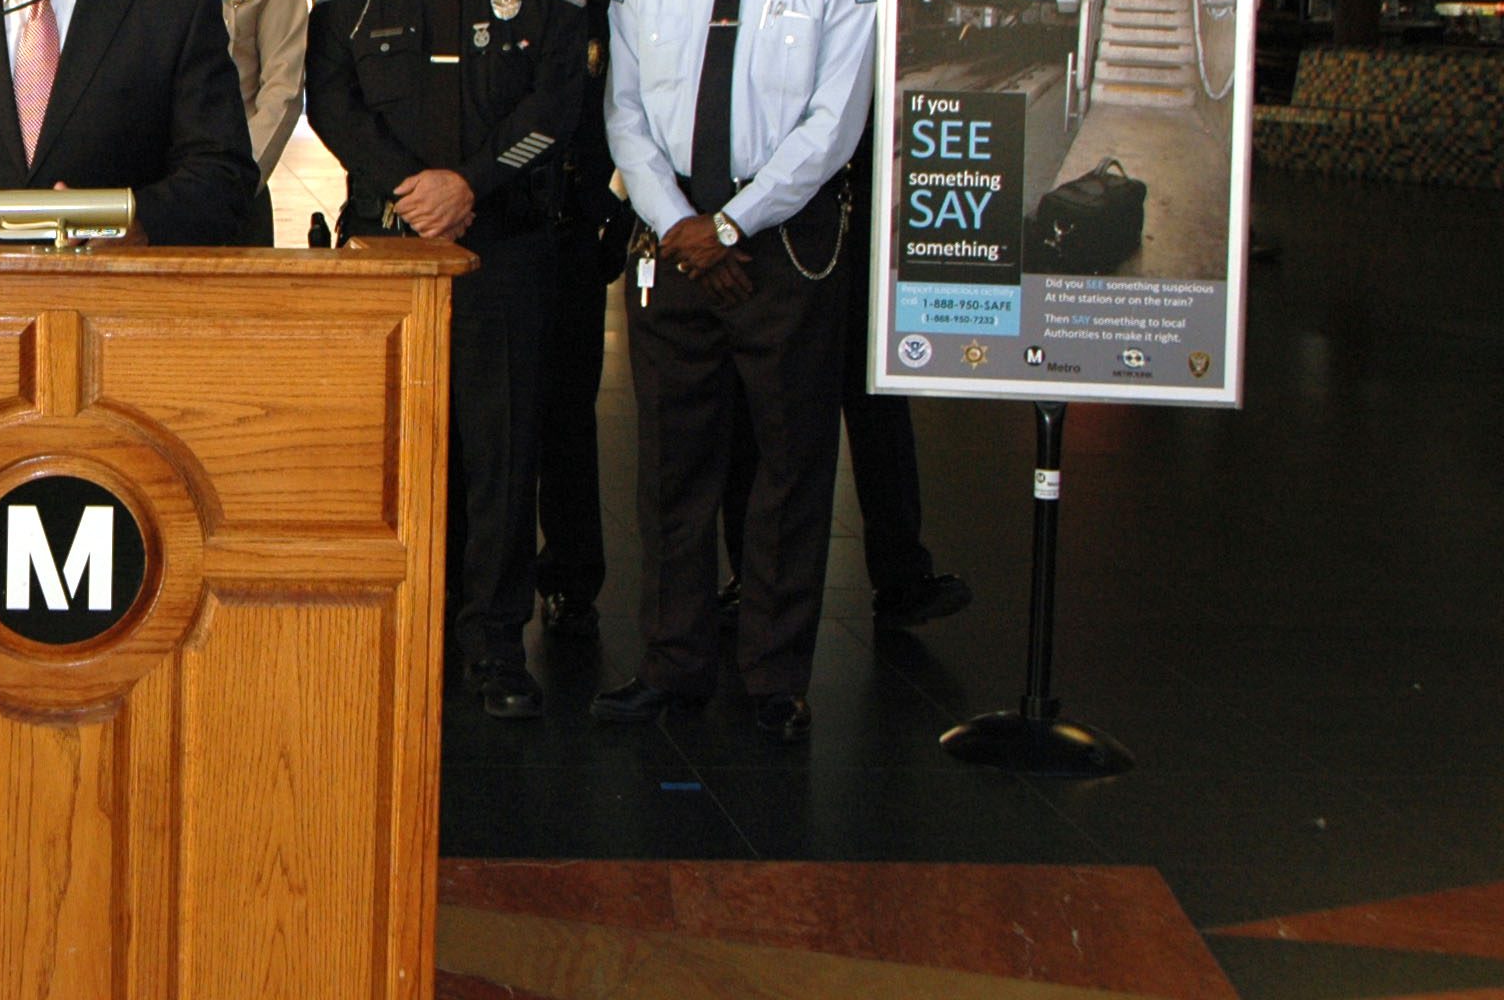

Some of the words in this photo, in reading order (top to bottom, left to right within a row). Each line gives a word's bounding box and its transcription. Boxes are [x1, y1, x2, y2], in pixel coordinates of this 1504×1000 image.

[912, 95, 924, 111] If
[928, 99, 960, 115] you
[911, 119, 992, 159] SEE
[909, 171, 1001, 191] something
[909, 189, 992, 229] SAY
[907, 240, 998, 261] something
[1045, 279, 1063, 288] Did
[1064, 281, 1084, 291] you
[1086, 279, 1105, 290] SEE
[1106, 281, 1160, 294] something
[1161, 282, 1214, 295] suspicious
[923, 298, 1012, 312] 1-888-950-SAFE
[1045, 293, 1057, 302] At
[1058, 293, 1076, 302] the
[1078, 294, 1113, 304] station
[1114, 296, 1126, 304] or
[1128, 297, 1142, 305] on
[1144, 296, 1162, 306] the
[1164, 297, 1194, 307] train?
[1045, 314, 1070, 324] Then
[1071, 315, 1091, 325] SAY
[1093, 316, 1147, 329] something
[1148, 318, 1160, 328] to
[1161, 318, 1186, 329] local
[1043, 328, 1100, 340] Authorities
[1102, 331, 1113, 340] to
[1115, 331, 1143, 341] make
[1144, 331, 1152, 341] it
[1154, 332, 1182, 345] right.
[1027, 349, 1043, 364] M
[1047, 362, 1081, 374] Metro
[6, 505, 114, 610] M
